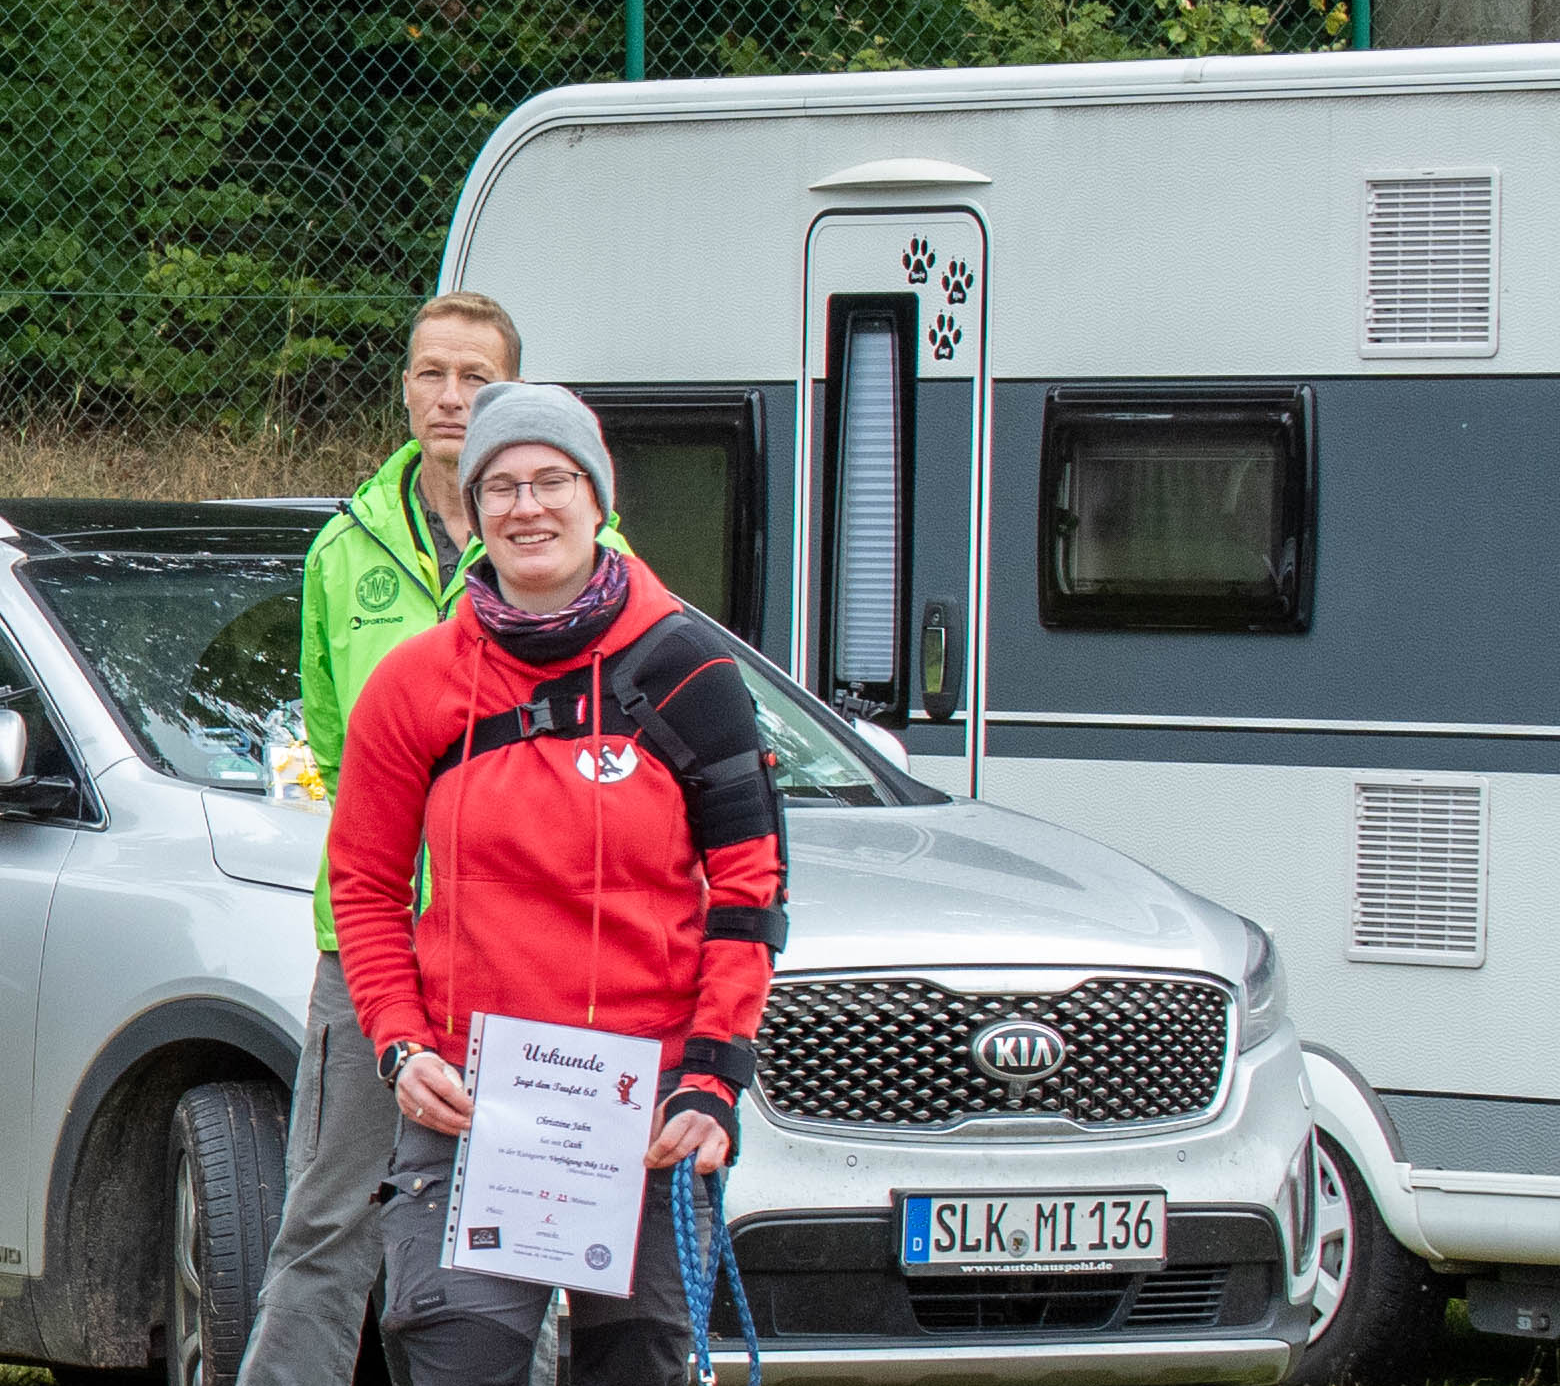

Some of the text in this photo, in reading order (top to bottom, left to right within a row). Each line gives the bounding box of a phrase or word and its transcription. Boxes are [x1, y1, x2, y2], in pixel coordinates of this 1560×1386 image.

[523, 1043, 605, 1072] Urkunde
[994, 1037, 1052, 1067] KIA
[934, 1200, 1153, 1253] SLK MI 136
[913, 1237, 923, 1252] D
[961, 1261, 1113, 1274] www.autohauspohl.de
